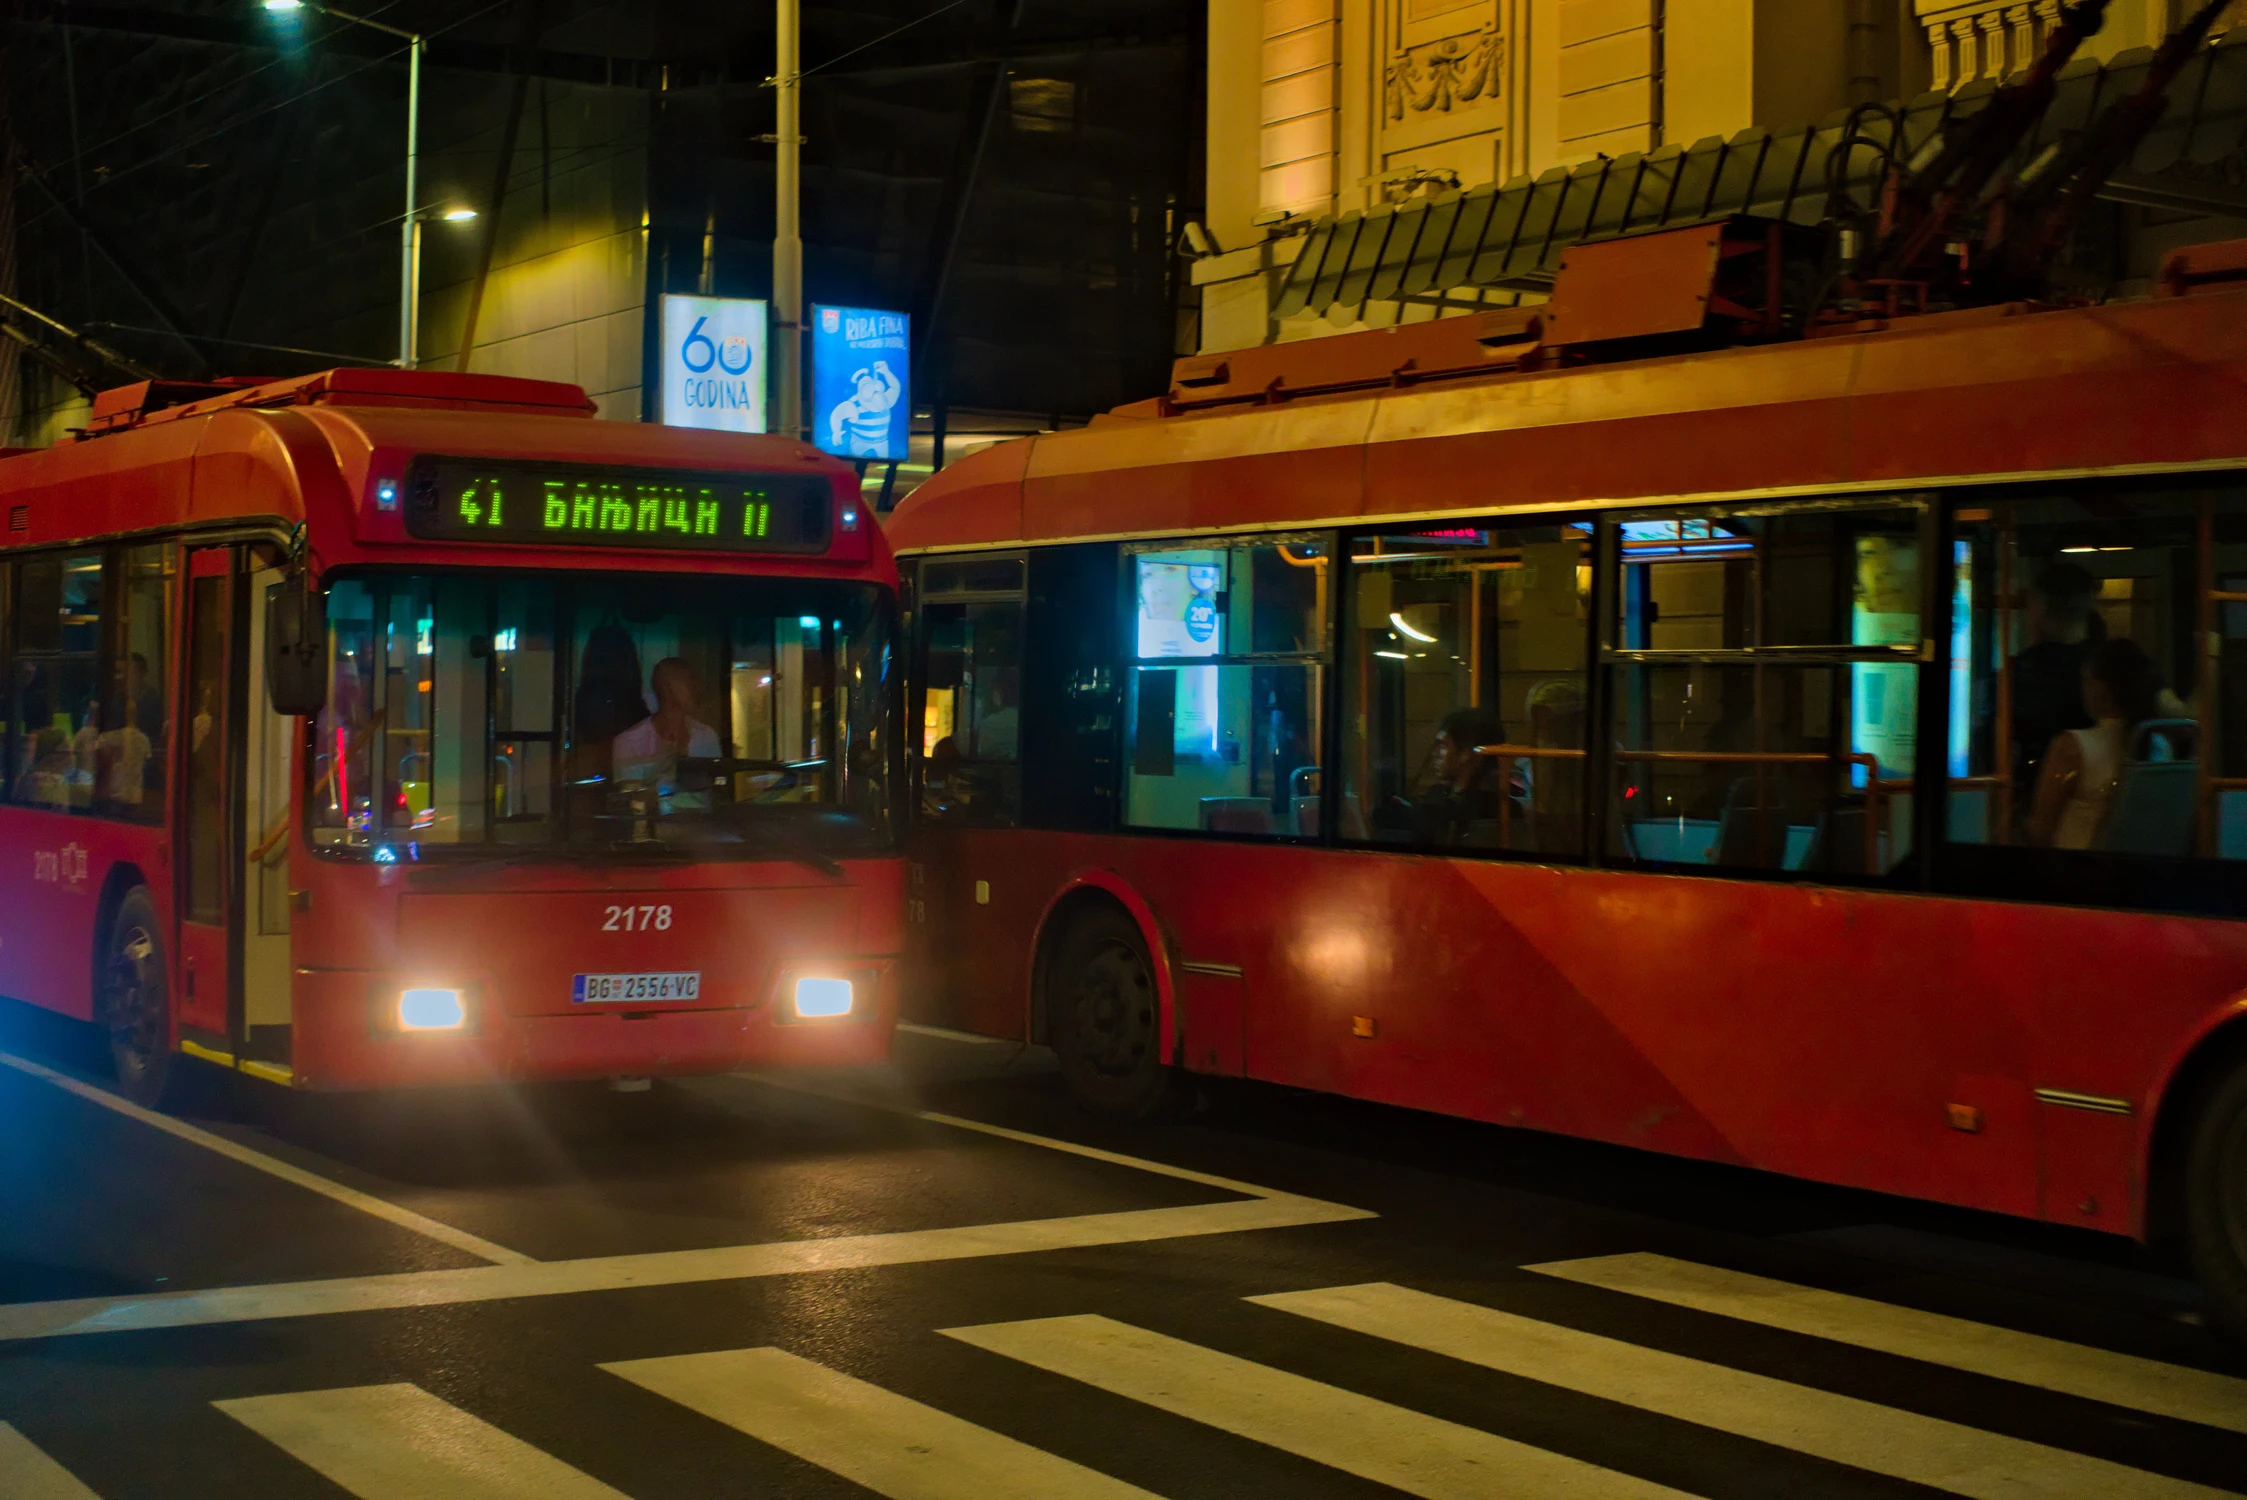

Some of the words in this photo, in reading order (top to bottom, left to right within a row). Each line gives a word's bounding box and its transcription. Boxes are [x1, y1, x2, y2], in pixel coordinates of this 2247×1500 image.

[845, 316, 877, 341] RIBA
[879, 316, 904, 335] FINA
[681, 316, 752, 376] 60
[684, 378, 751, 410] GODINA
[459, 478, 504, 527] 41
[602, 904, 672, 932] 2178
[587, 977, 612, 999] BG
